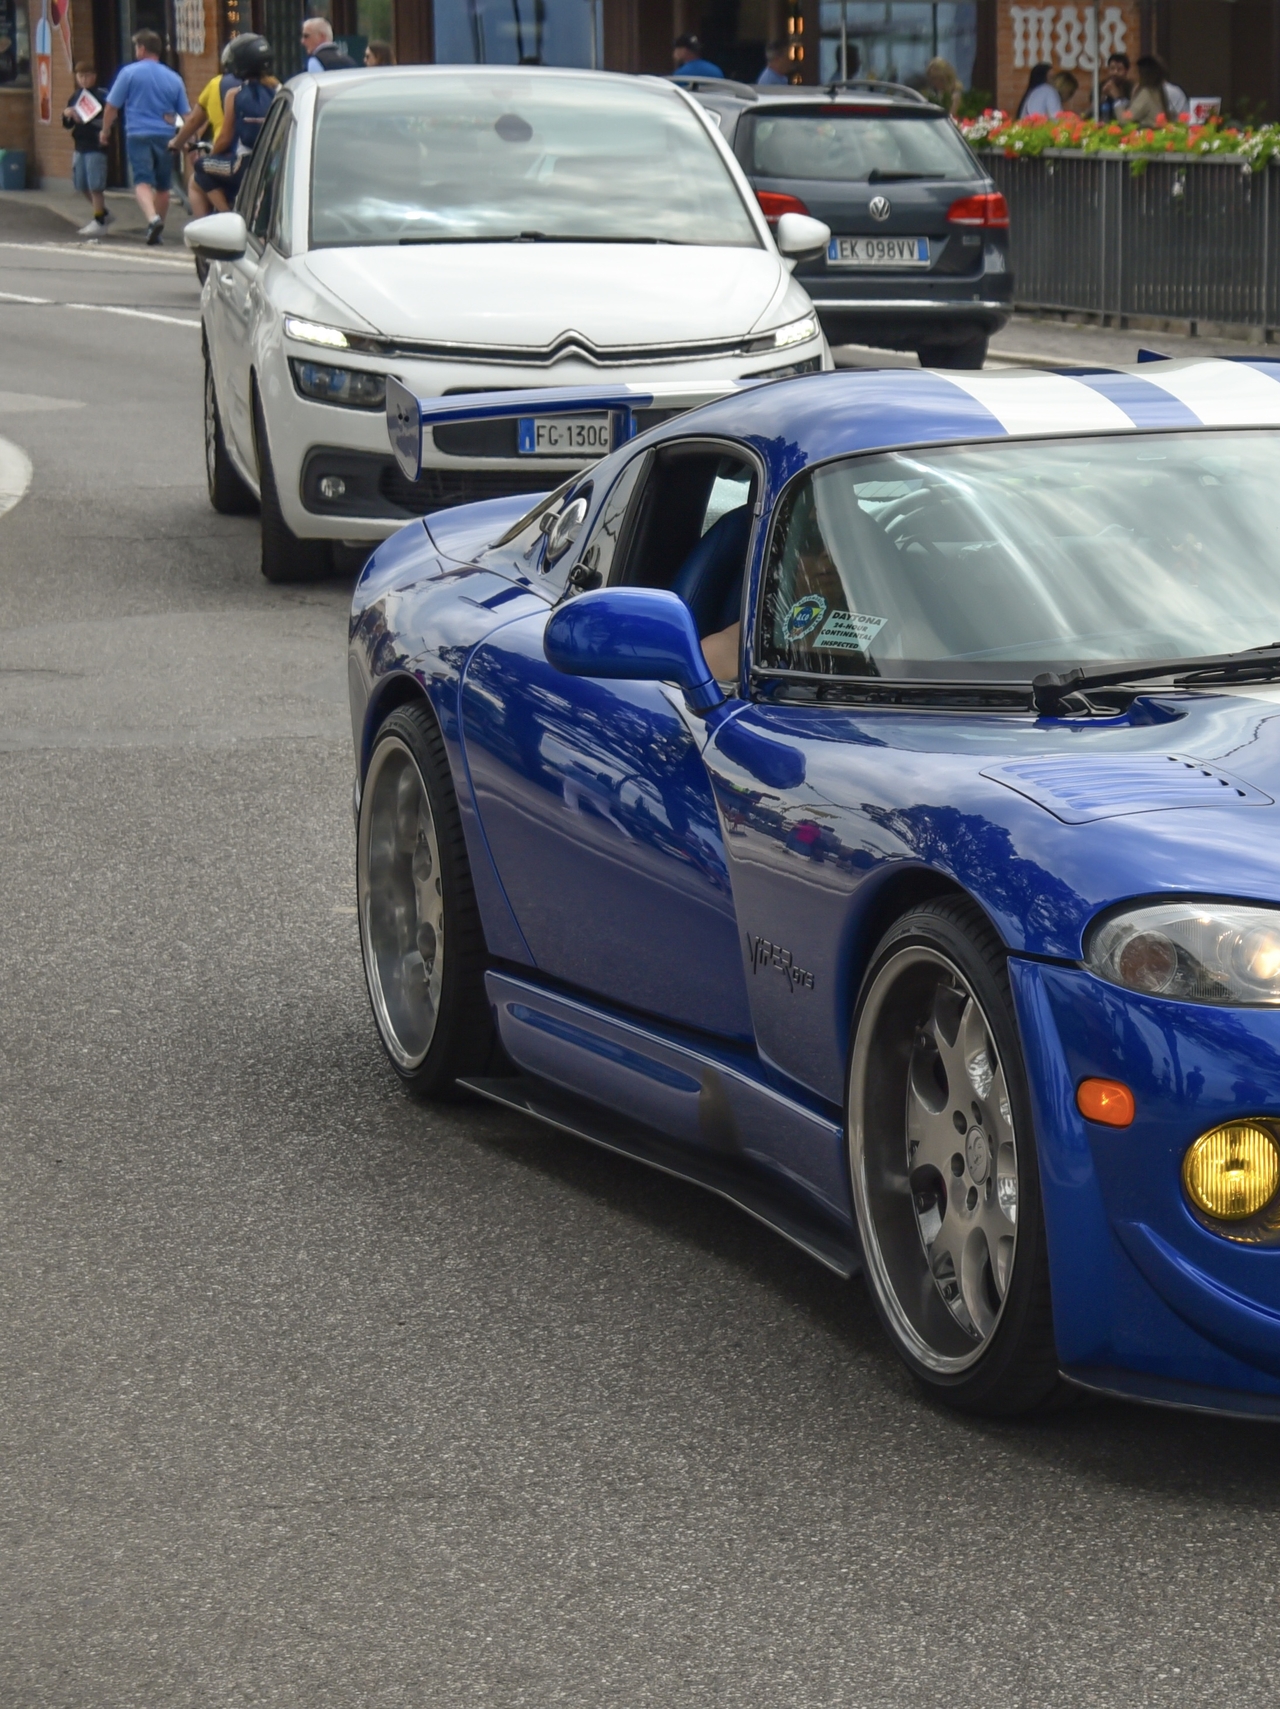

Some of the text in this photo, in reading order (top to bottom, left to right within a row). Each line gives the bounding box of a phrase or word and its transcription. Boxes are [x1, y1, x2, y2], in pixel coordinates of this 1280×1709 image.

[840, 240, 859, 259] EK
[866, 240, 916, 260] 098VV
[536, 425, 559, 446] FG
[567, 425, 608, 447] 130G
[832, 611, 882, 626] DAYTONA
[820, 628, 872, 641] CONTINENTAL
[833, 622, 868, 633] 24-HOUR
[820, 640, 860, 650] INSPECTED
[746, 931, 815, 994] VIPER GTS
